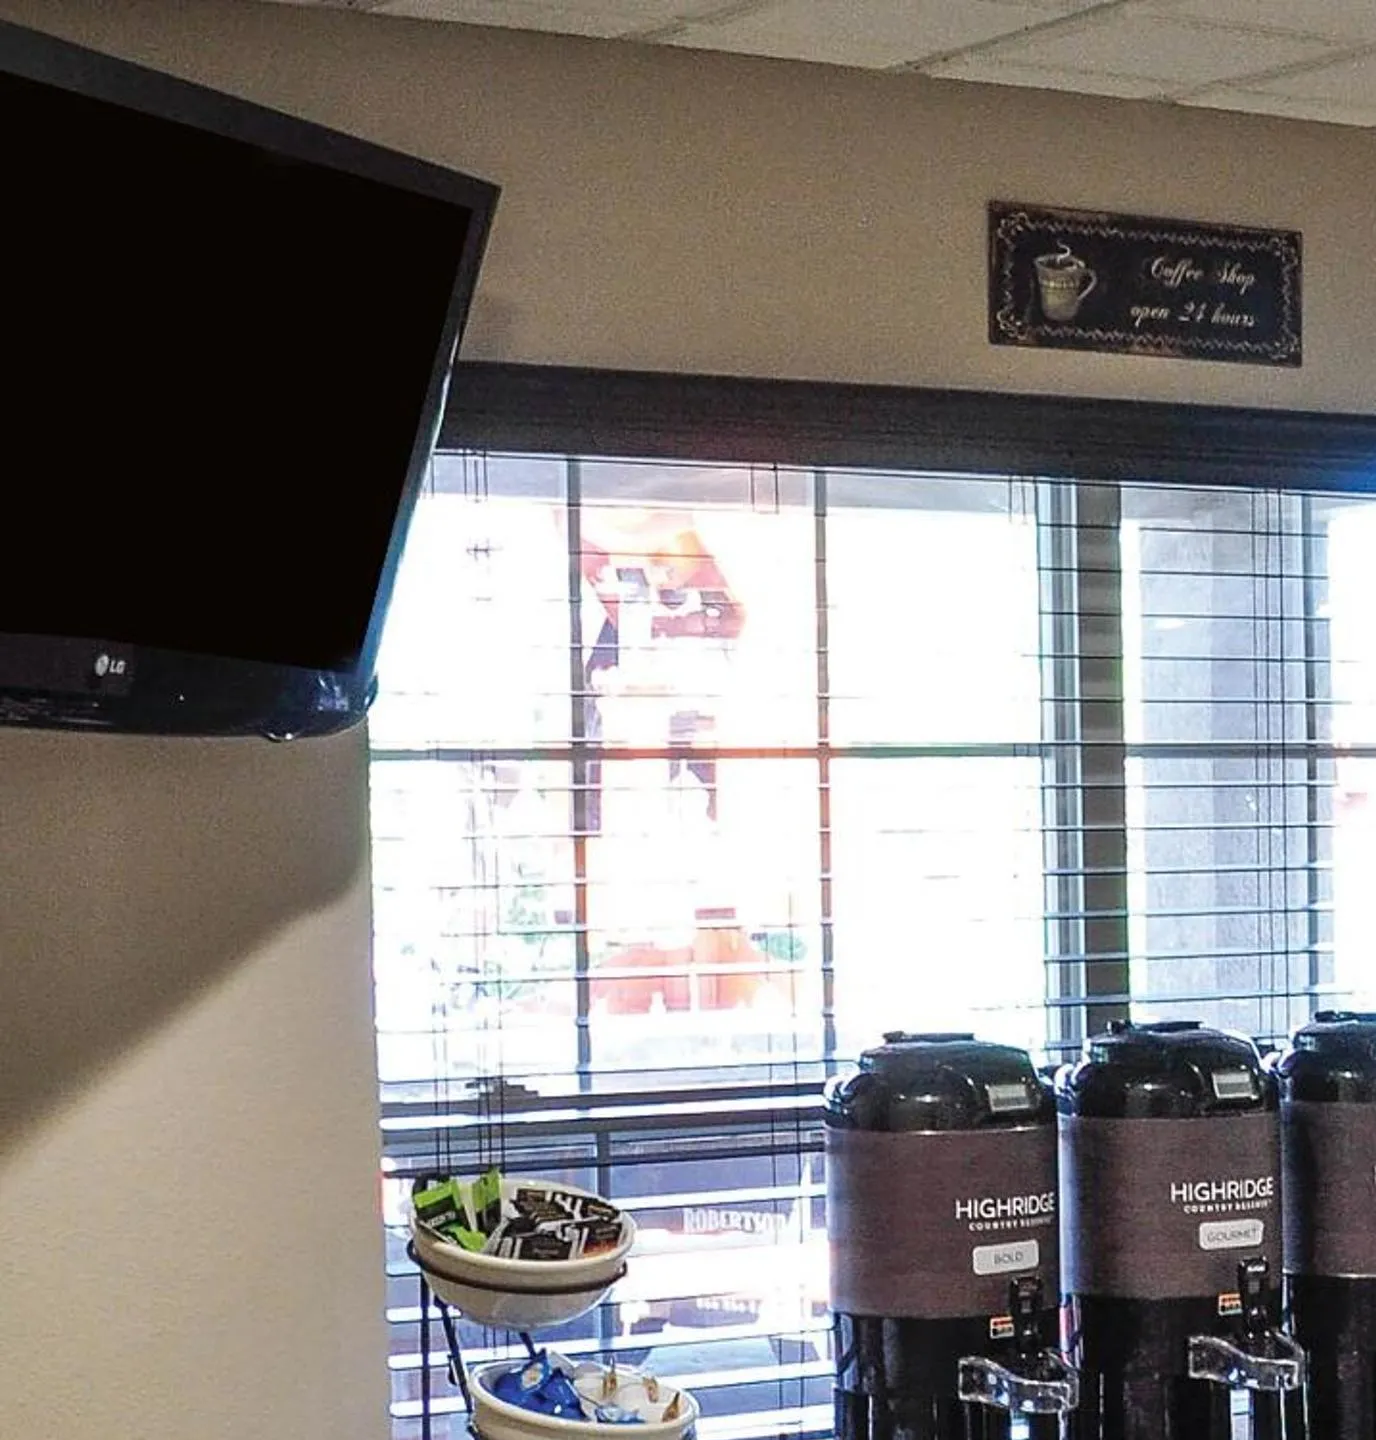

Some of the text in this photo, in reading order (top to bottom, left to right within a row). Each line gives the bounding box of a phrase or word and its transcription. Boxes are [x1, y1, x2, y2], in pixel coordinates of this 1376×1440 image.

[1151, 256, 1203, 288] Coffee
[1130, 301, 1255, 328] open 24 hours
[1170, 1176, 1274, 1203] HIGHRIDGE
[955, 1191, 1055, 1220] HIGHRIDGE
[994, 1250, 1024, 1265] BOLD
